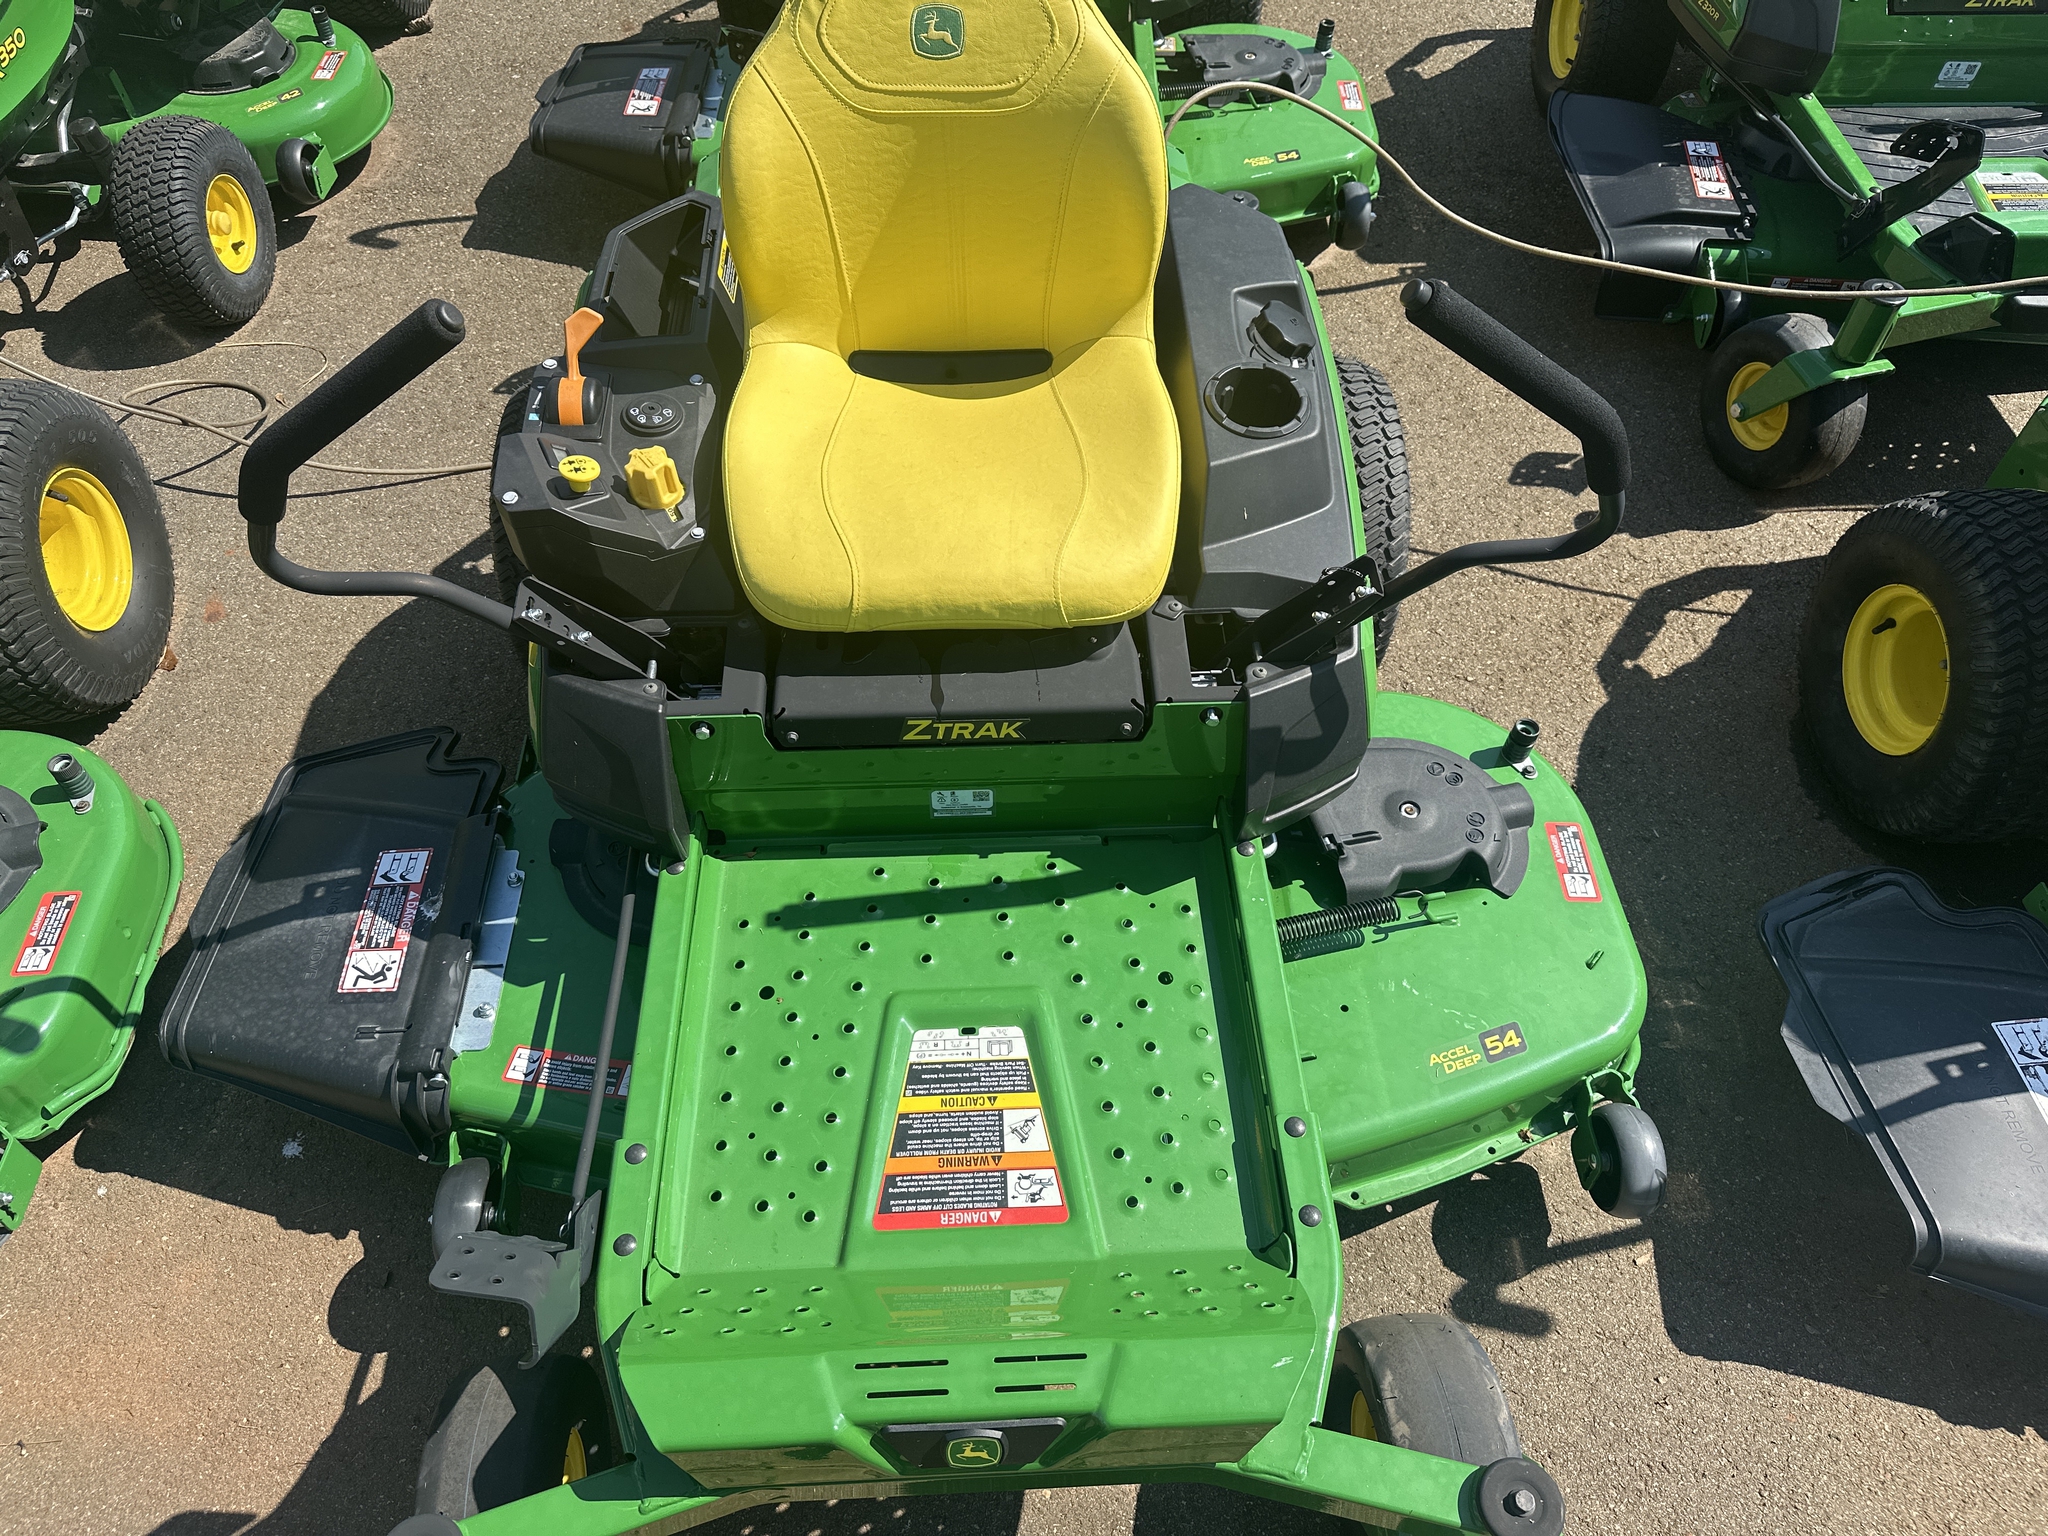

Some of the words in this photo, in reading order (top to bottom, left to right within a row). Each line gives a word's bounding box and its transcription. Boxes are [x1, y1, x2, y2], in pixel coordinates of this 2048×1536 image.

[280, 89, 301, 101] 42
[1276, 151, 1300, 162] 54
[68, 429, 98, 444] 505
[902, 719, 1024, 741] ZTRAK
[1550, 834, 1563, 858] DANGER
[32, 906, 47, 930] DANGER
[396, 902, 416, 942] DANGER
[1429, 1044, 1474, 1067] ACCEL
[1484, 1029, 1522, 1055] 54
[1443, 1053, 1482, 1074] DEEP
[940, 1096, 985, 1108] CAUTION
[2002, 1109, 2046, 1175] REMOVE
[938, 1156, 989, 1168] WARNING
[941, 1212, 987, 1224] DANGER
